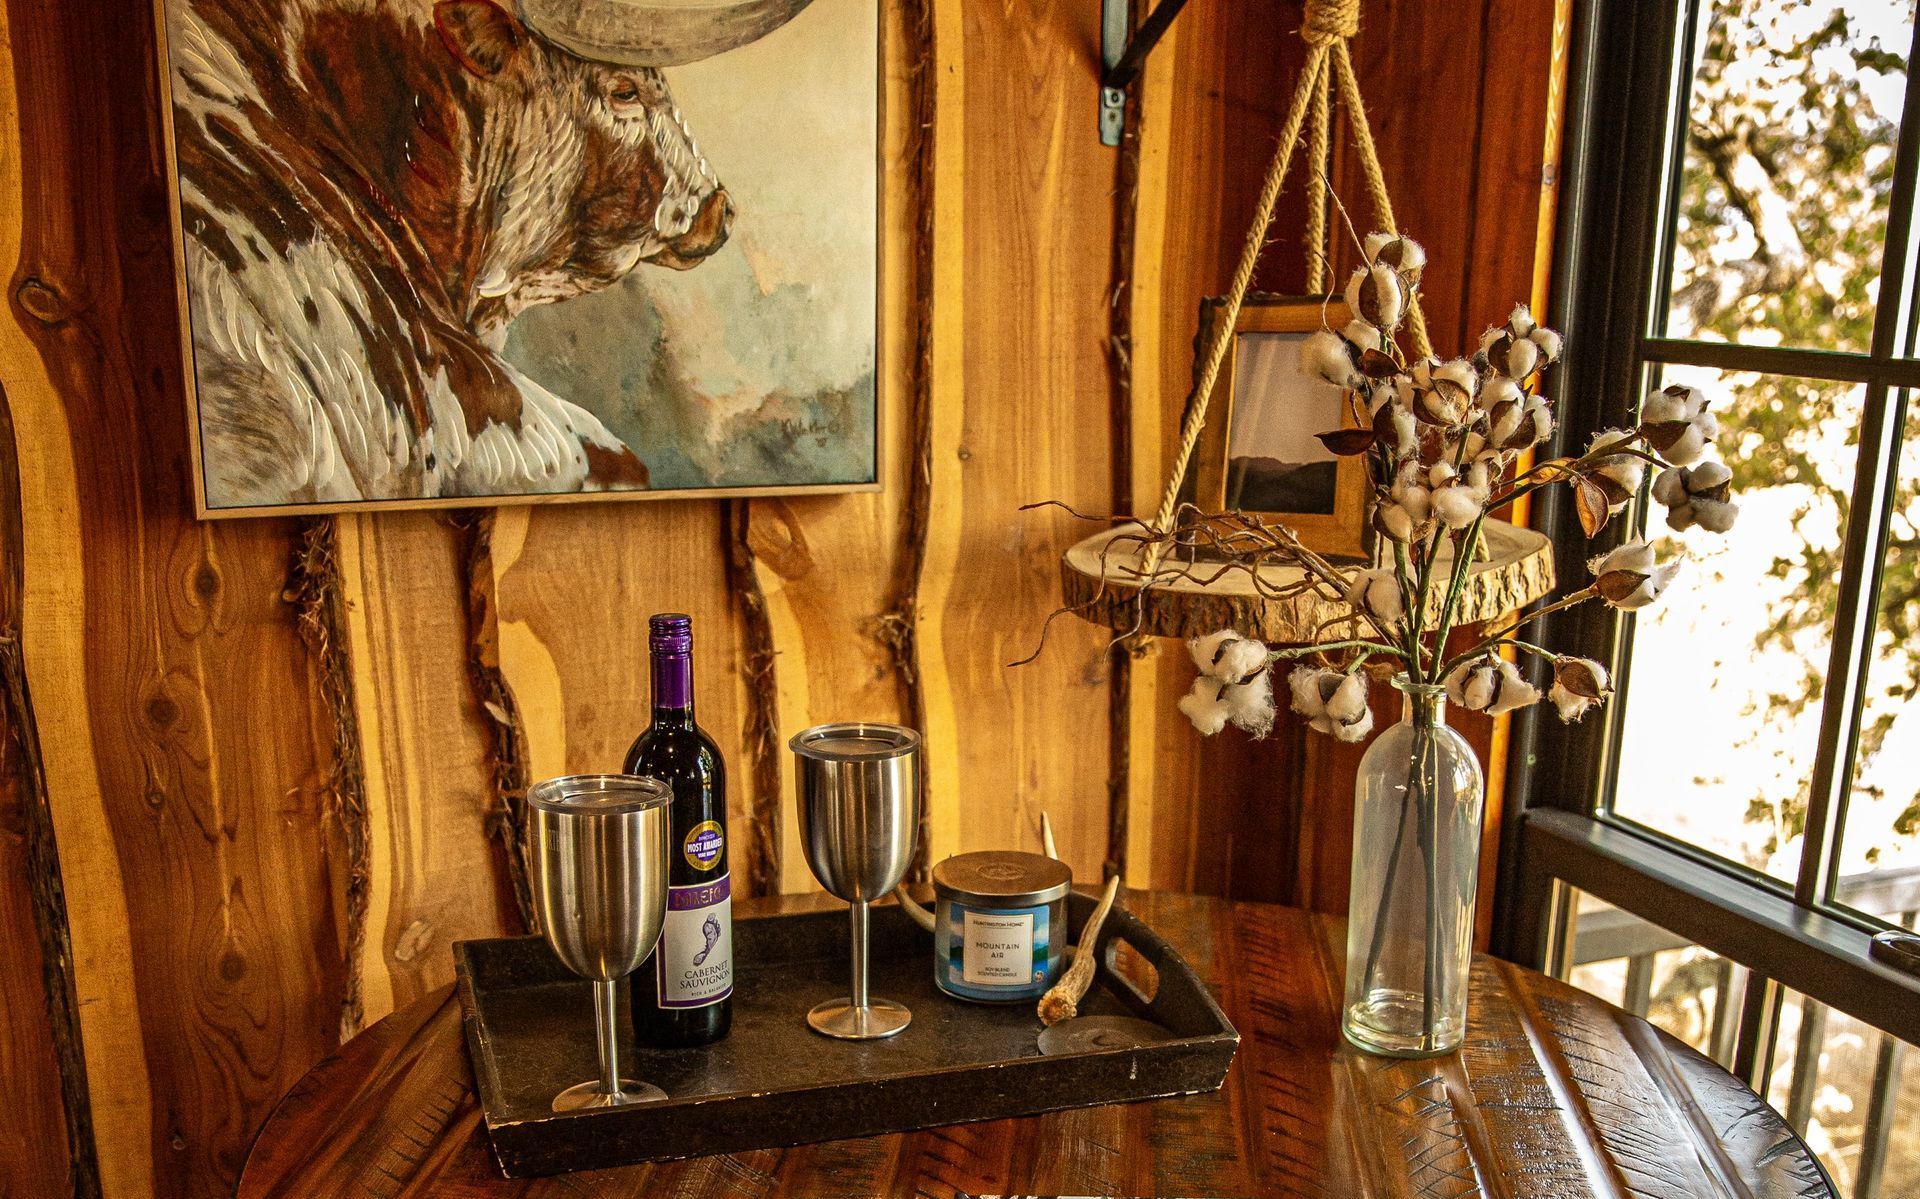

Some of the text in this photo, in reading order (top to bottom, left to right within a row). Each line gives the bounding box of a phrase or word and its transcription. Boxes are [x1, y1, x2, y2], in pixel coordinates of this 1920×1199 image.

[687, 843, 702, 853] MOST
[975, 942, 1020, 950] MOUNTAIN
[684, 959, 728, 979] CABERNET
[679, 970, 730, 990] SAUVIGNON
